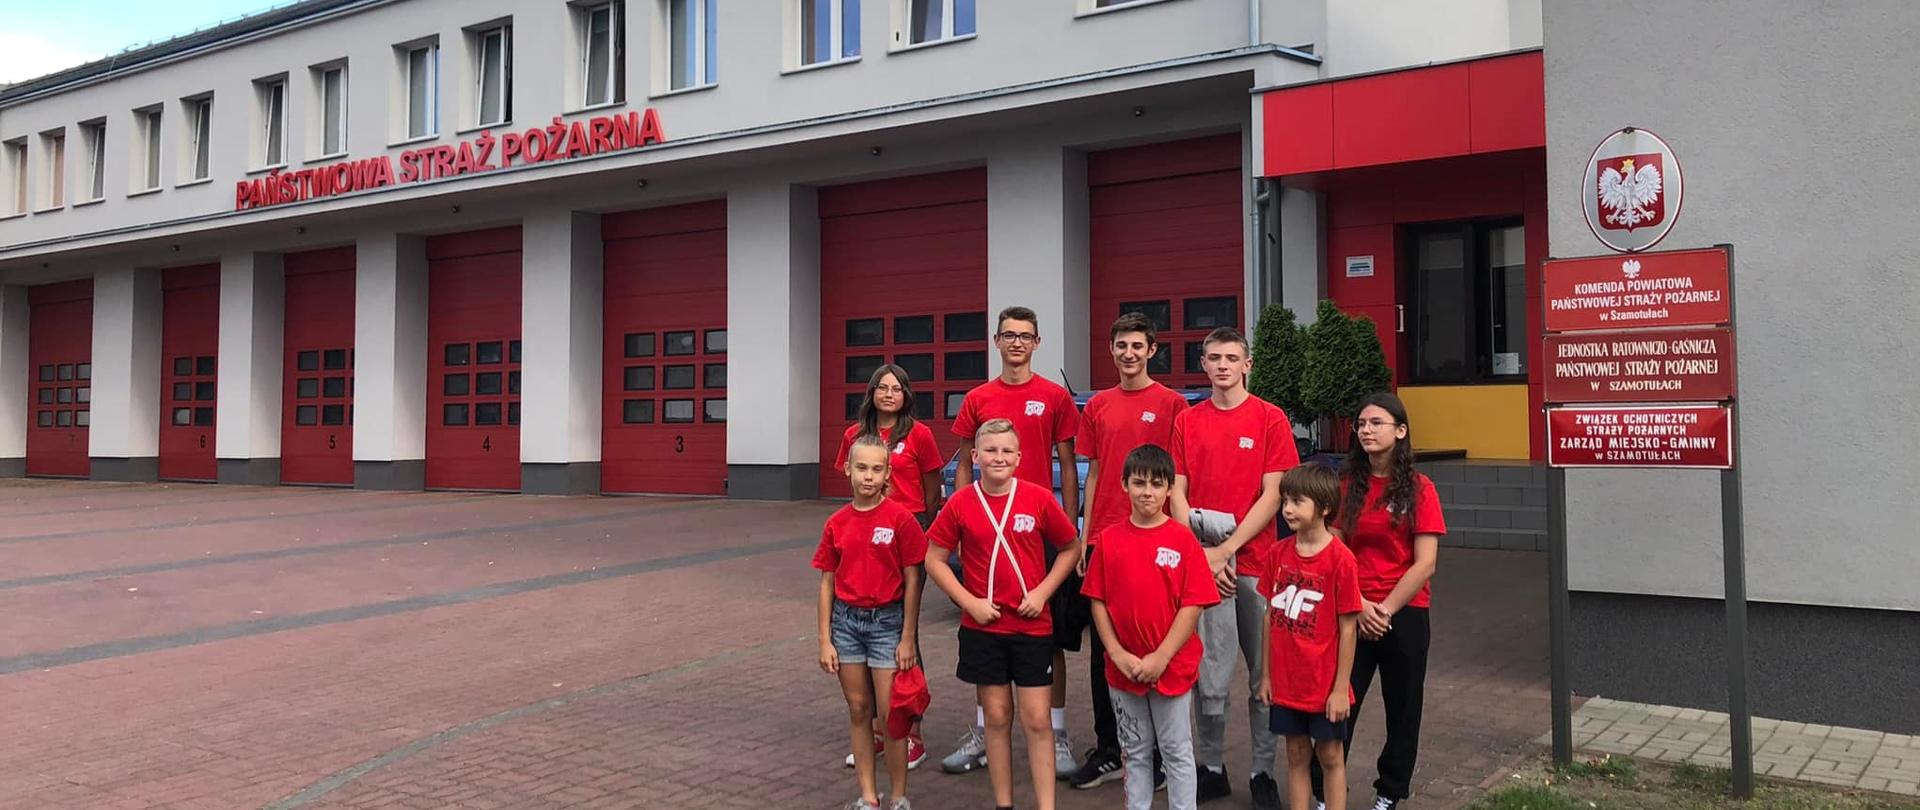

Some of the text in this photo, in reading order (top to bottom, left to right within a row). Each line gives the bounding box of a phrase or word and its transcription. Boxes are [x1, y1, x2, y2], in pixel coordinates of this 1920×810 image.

[235, 108, 665, 211] PAŃSTWOWA STRAŻ POŻARNA
[1574, 277, 1693, 295] KOMENDA POWIATOWA
[1551, 290, 1721, 310] PAŃSTWOWEJ STRAŻY POŻARNEJ
[1600, 308, 1669, 321] w Szamotułach
[1558, 338, 1717, 358] JEDNOSTKA RATOWNICZO-GAŚNICZA
[1556, 358, 1719, 377] PAŃSTWOWEJ STRAŻY POŻARNEJ
[1590, 380, 1682, 391] W SZAMOTUŁACH
[1576, 413, 1698, 426] ZWIĄZEK OCHOTNICZYCH
[1586, 425, 1687, 435] STRAŻY POŻARNYCH
[200, 434, 206, 448] 6
[329, 435, 336, 449] 5
[482, 435, 491, 452] 4
[675, 435, 684, 453] 3
[1560, 438, 1603, 451] ZARZĄD
[1607, 451, 1681, 460] SZAMOTUŁACH
[1270, 584, 1325, 621] 4F
